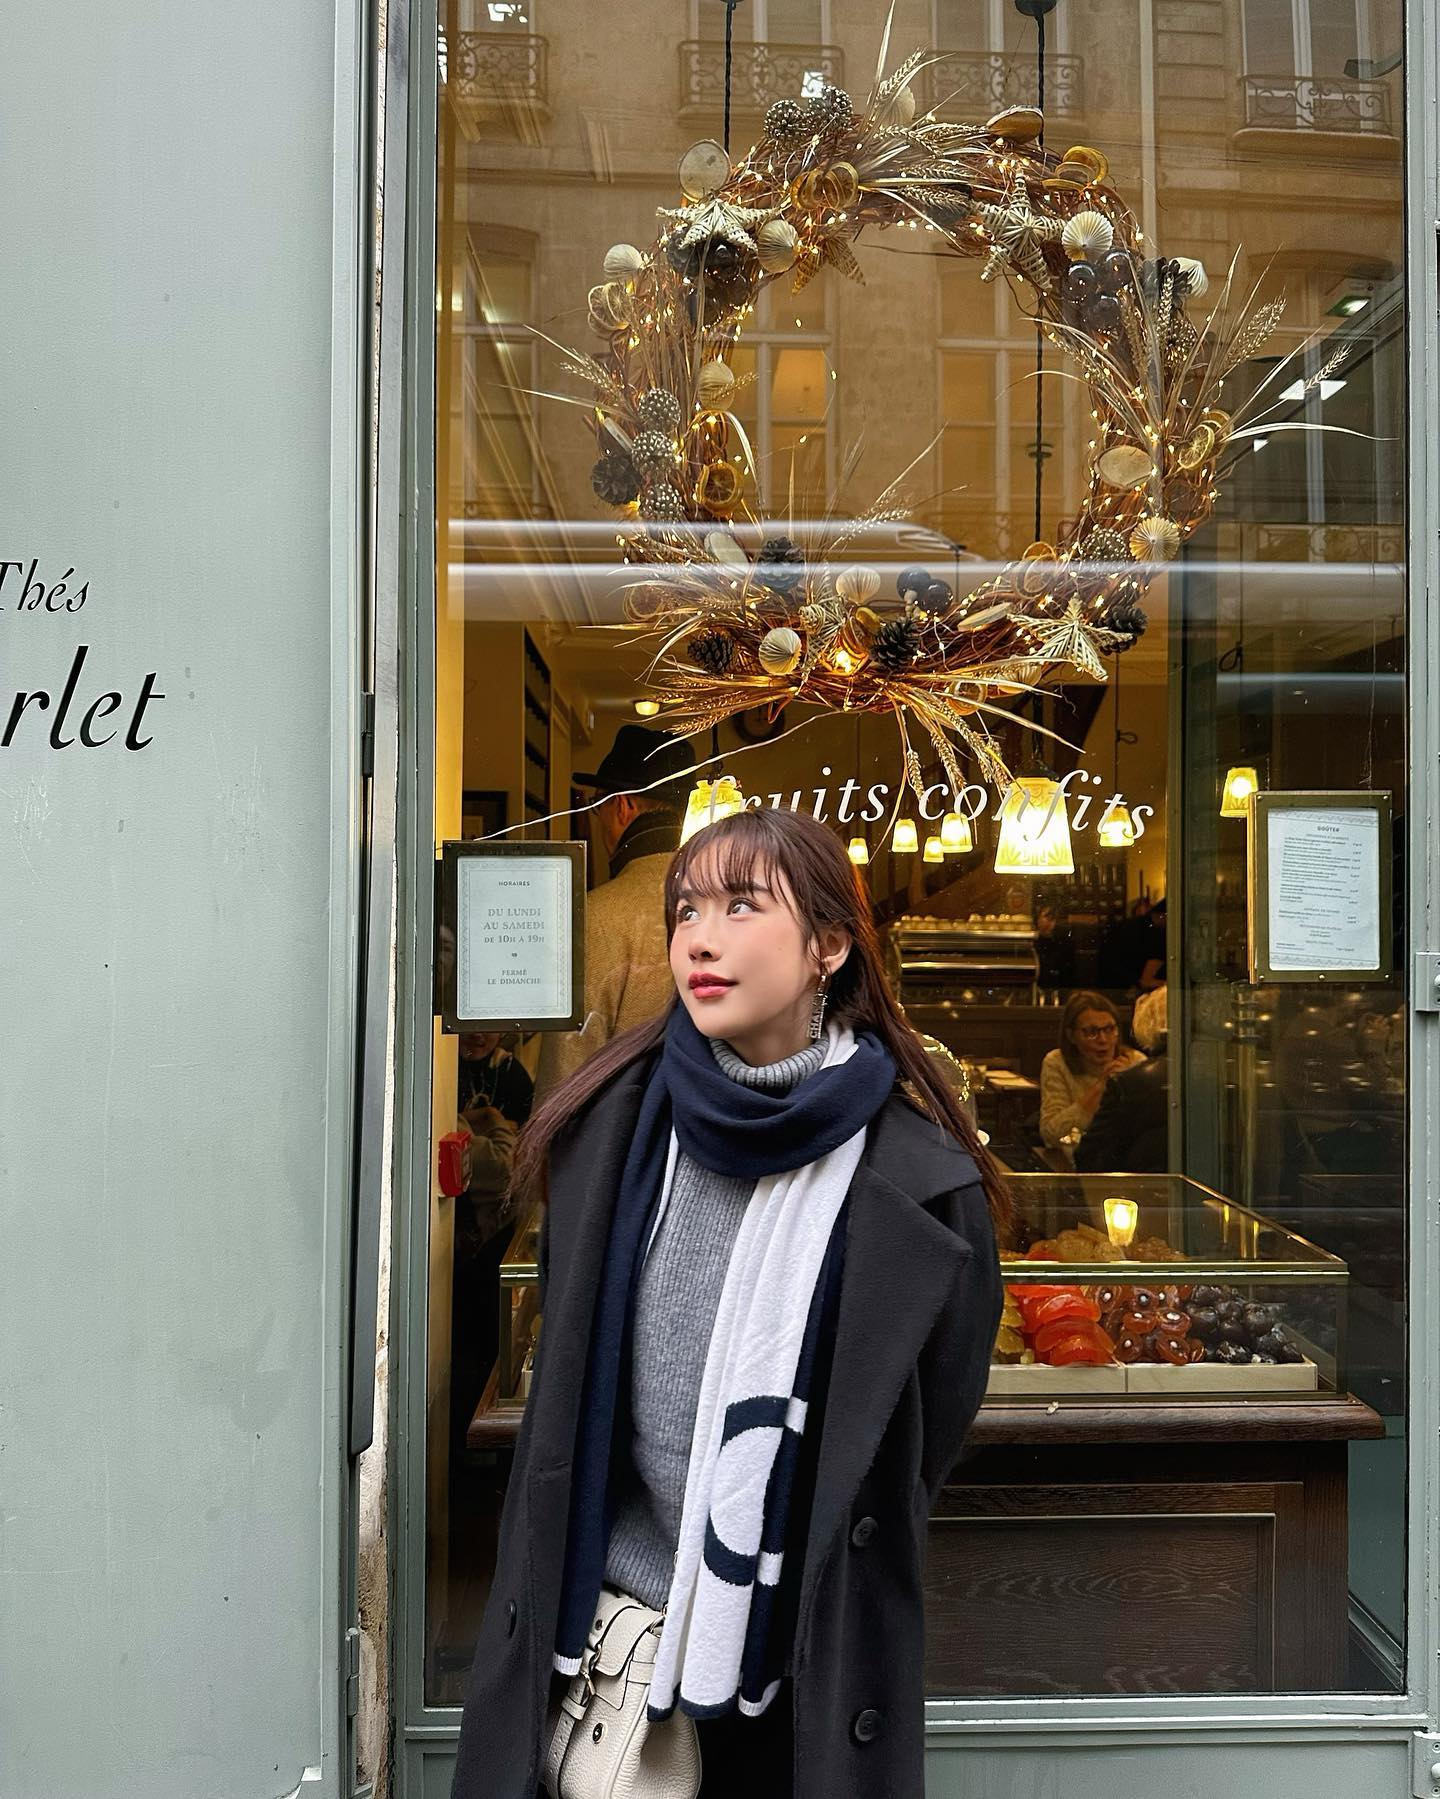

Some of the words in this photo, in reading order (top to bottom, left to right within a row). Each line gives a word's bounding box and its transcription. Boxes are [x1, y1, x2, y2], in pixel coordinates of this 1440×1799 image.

[0, 558, 90, 613] Thés
[0, 645, 166, 751] rlet
[917, 769, 1154, 840] confits
[483, 921, 499, 930] AU
[502, 921, 545, 930] SAMEDI
[488, 908, 504, 917] DU
[507, 908, 541, 917] LUNDI
